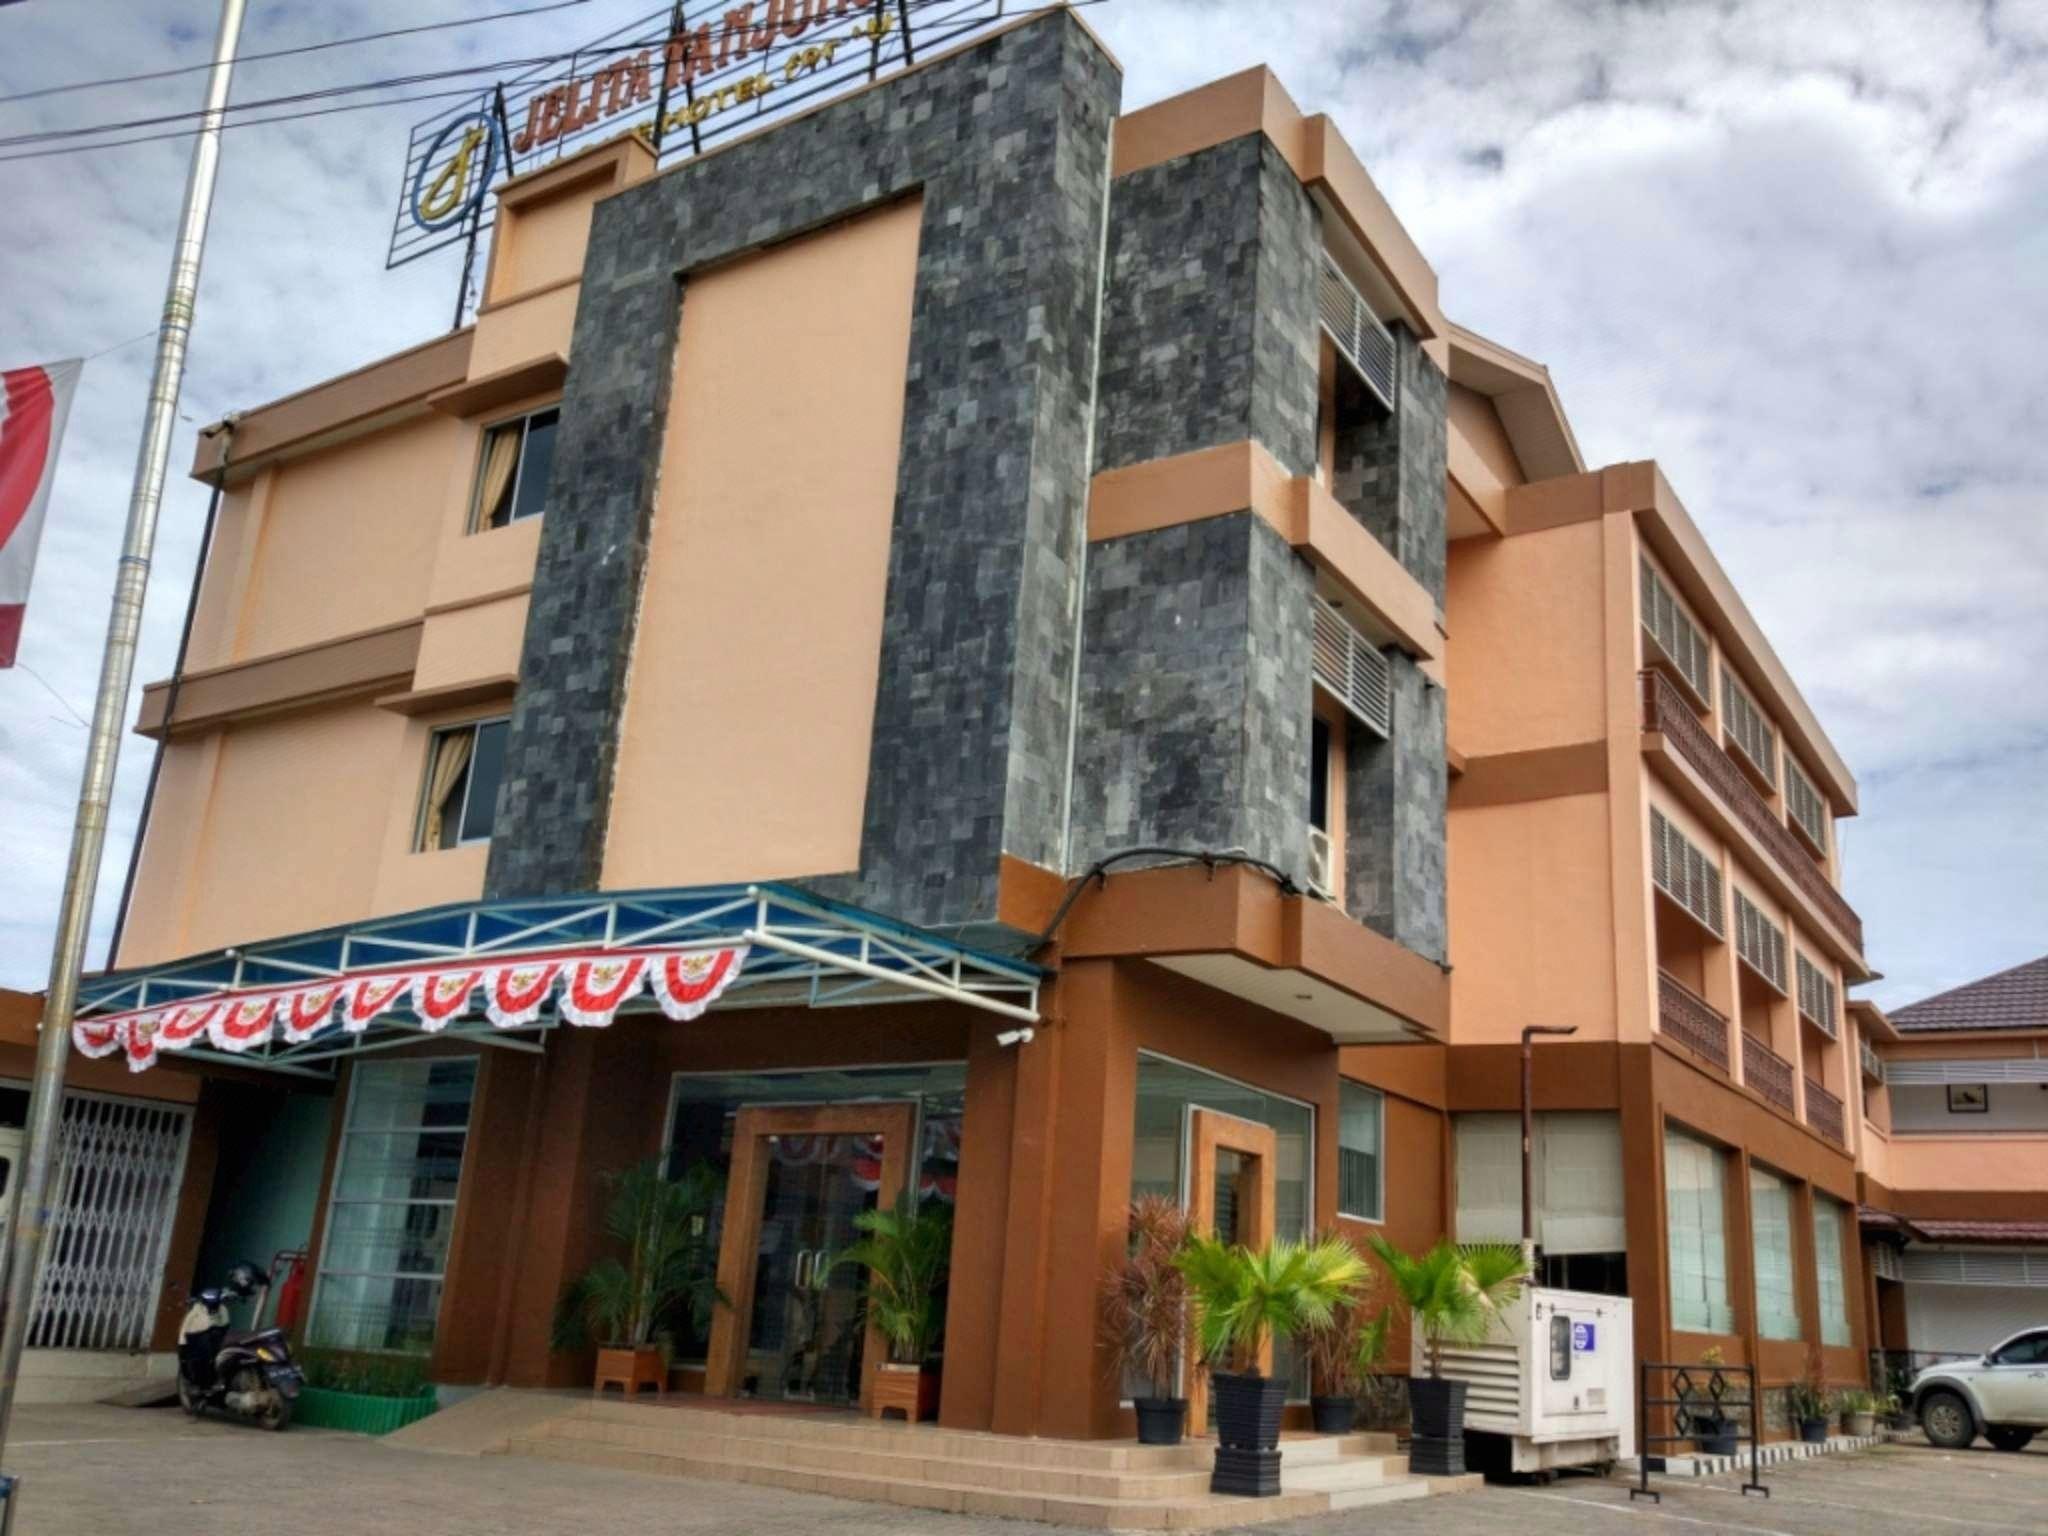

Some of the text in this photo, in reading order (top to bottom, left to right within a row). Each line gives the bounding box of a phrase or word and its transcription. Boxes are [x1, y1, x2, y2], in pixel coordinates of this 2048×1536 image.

[513, 50, 652, 153] JELITA
[664, 0, 875, 89] TANJU
[661, 72, 774, 134] HOTEL
